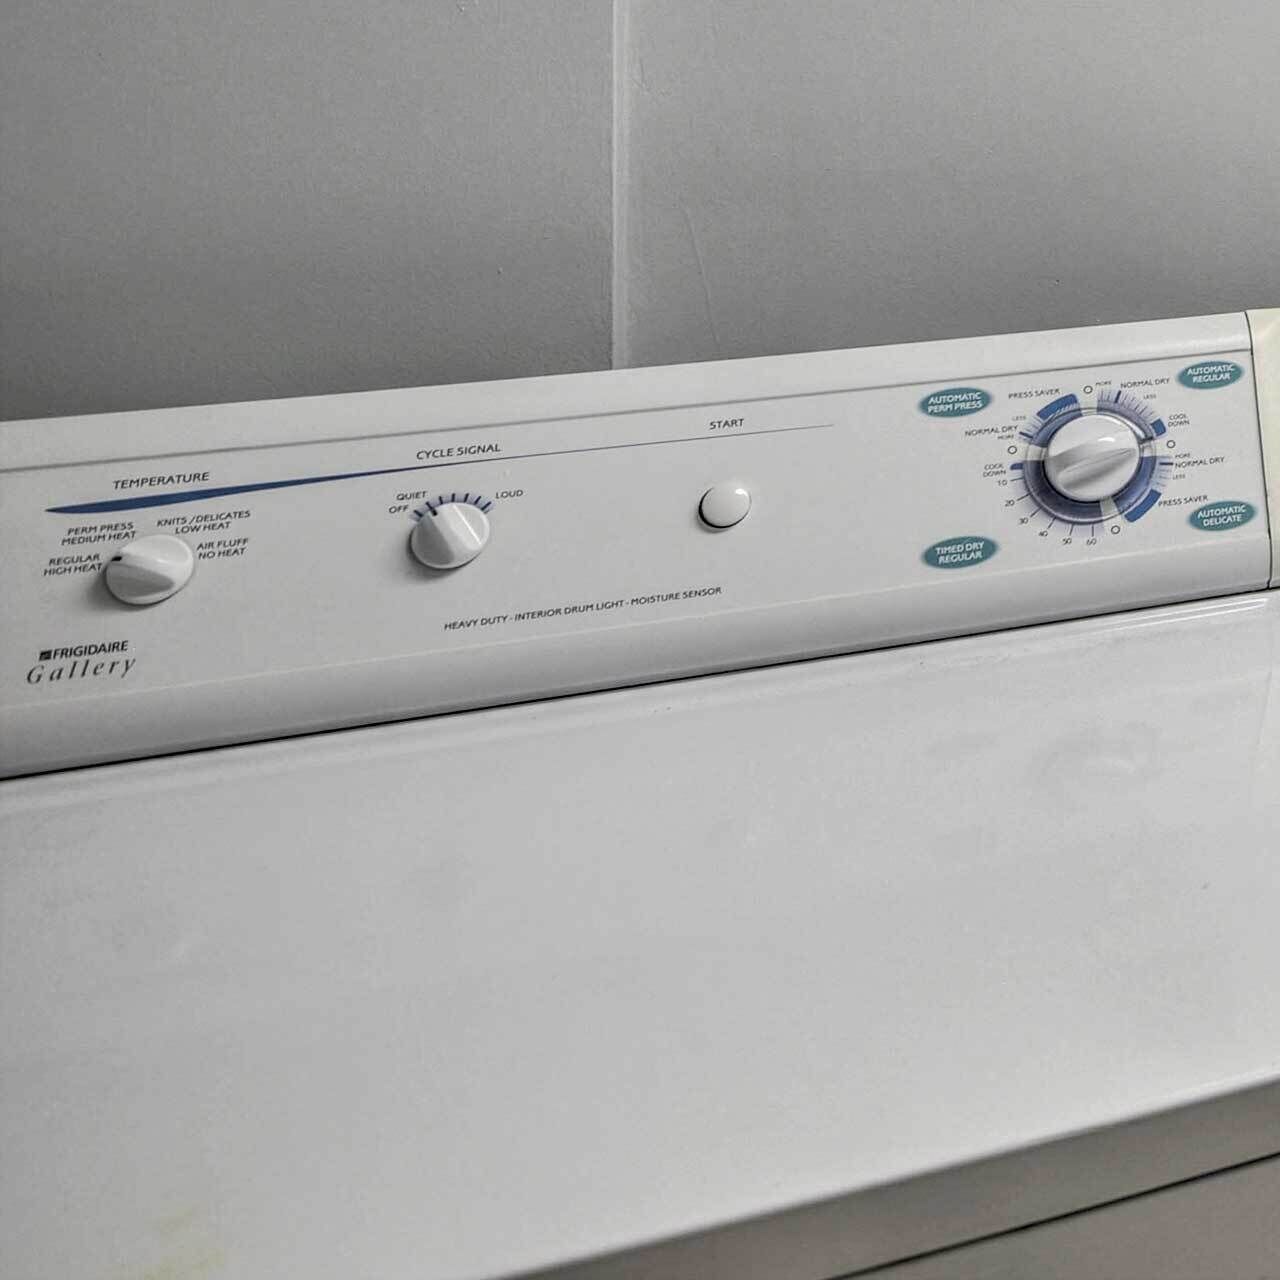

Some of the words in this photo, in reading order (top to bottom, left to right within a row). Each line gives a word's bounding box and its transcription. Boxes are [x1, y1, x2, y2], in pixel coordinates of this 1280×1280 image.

[1187, 363, 1235, 375] AUTOMATIC
[1120, 380, 1154, 389] NORMAL
[1154, 377, 1171, 386] DRY
[1192, 372, 1232, 384] REGULAR
[928, 392, 982, 405] AUTOMATIC
[928, 402, 954, 414] PERM
[954, 400, 983, 411] PRESS
[710, 418, 745, 430] START
[964, 426, 999, 437] NORMAL
[999, 424, 1019, 433] DRY
[416, 448, 454, 461] CYCLE
[456, 443, 502, 457] SIGNAL
[112, 471, 211, 490] TEMPERATURE
[396, 490, 428, 501] QUIET
[495, 489, 524, 500] LOUD
[388, 505, 409, 514] OFF
[1004, 499, 1015, 508] 20
[1197, 504, 1247, 519] AUTOMATIC
[156, 516, 188, 528] KNITS
[1018, 517, 1029, 525] 30
[1202, 514, 1242, 527] DELICATE
[67, 524, 99, 536] PERM
[99, 522, 135, 533] PRESS
[174, 523, 201, 535] LOW
[201, 521, 232, 532] HEAT
[1038, 530, 1049, 538] 40
[61, 534, 107, 546] MEDIUM
[107, 531, 137, 541] HEAT
[196, 541, 216, 551] AIR
[216, 538, 250, 549] FLUFF
[1062, 538, 1072, 546] 50
[1086, 538, 1098, 546] 60
[198, 550, 217, 560] NO
[217, 547, 247, 558] HEAT
[934, 543, 964, 556] TIMED
[965, 540, 985, 551] DRY
[48, 553, 101, 567] REGULAR
[938, 551, 984, 565] REGULAR
[43, 566, 73, 577] HIGH
[72, 562, 103, 573] HEAT
[630, 591, 681, 607] MOISTURE
[681, 586, 723, 600] SENSOR
[514, 607, 562, 622] INTERIOR
[564, 603, 595, 616] DRUM
[595, 599, 625, 611] LIGHT
[443, 619, 480, 632] HEAVY
[480, 614, 508, 627] DUTY
[53, 639, 129, 660] FRIGIDAIRE
[26, 658, 136, 685] Gallery
